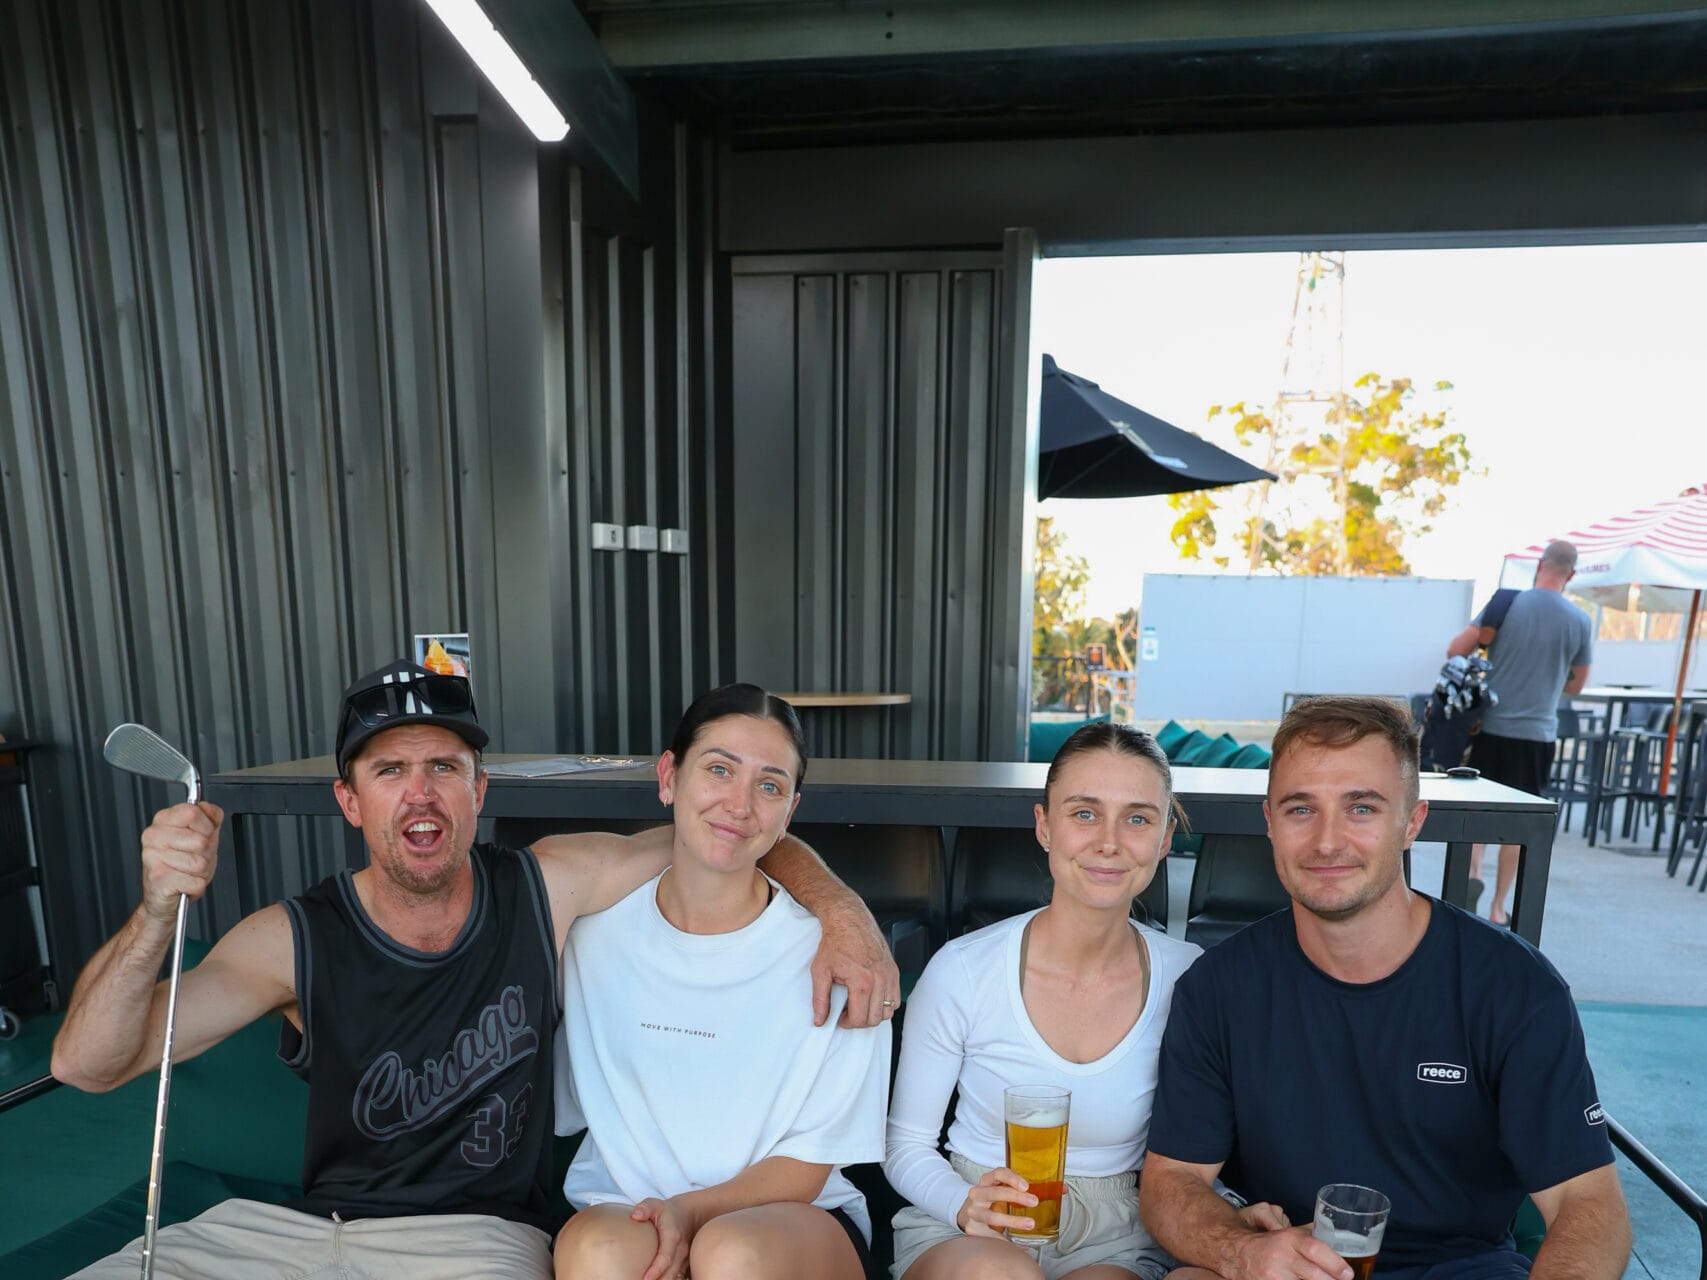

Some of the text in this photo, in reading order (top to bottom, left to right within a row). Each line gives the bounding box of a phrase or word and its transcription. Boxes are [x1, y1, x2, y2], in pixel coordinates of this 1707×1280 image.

[640, 1022, 662, 1030] MOVE
[685, 1028, 716, 1039] PURPOSE
[353, 985, 538, 1141] Chicago
[1423, 1066, 1462, 1079] reece
[1589, 1109, 1604, 1120] ree
